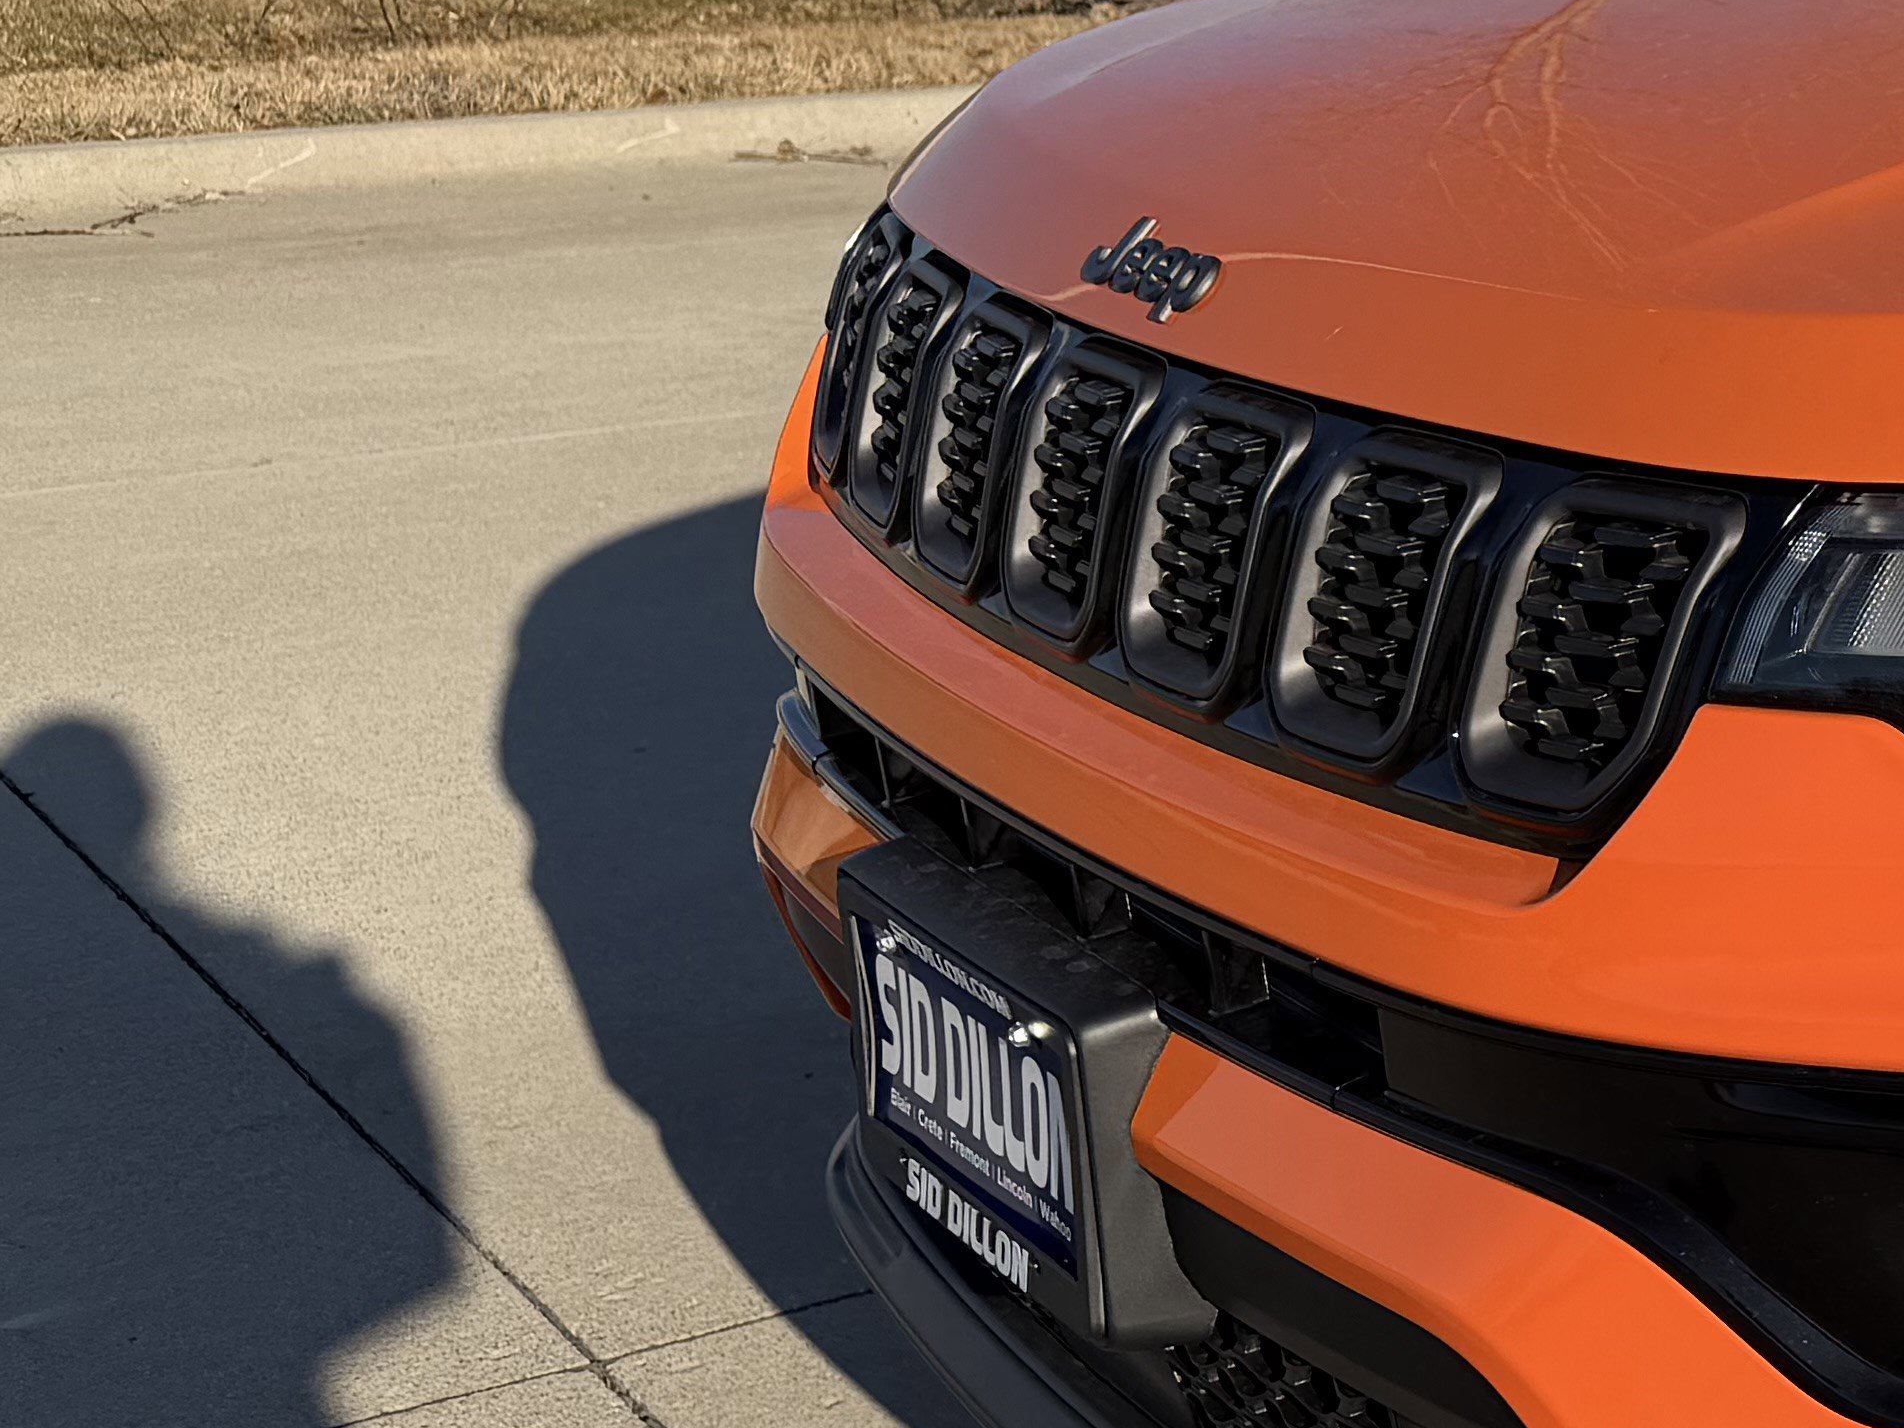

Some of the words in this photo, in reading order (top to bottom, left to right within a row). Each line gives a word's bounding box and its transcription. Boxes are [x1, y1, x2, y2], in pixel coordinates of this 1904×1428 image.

[1080, 216, 1222, 323] Jeep
[875, 953, 937, 1104] SID
[941, 996, 1075, 1216] DILLON
[918, 1108, 943, 1141] Crete
[949, 1130, 990, 1177] Fremont
[997, 1166, 1033, 1209] Lincoln
[905, 1157, 943, 1221] SID
[947, 1189, 1030, 1294] DILLON
